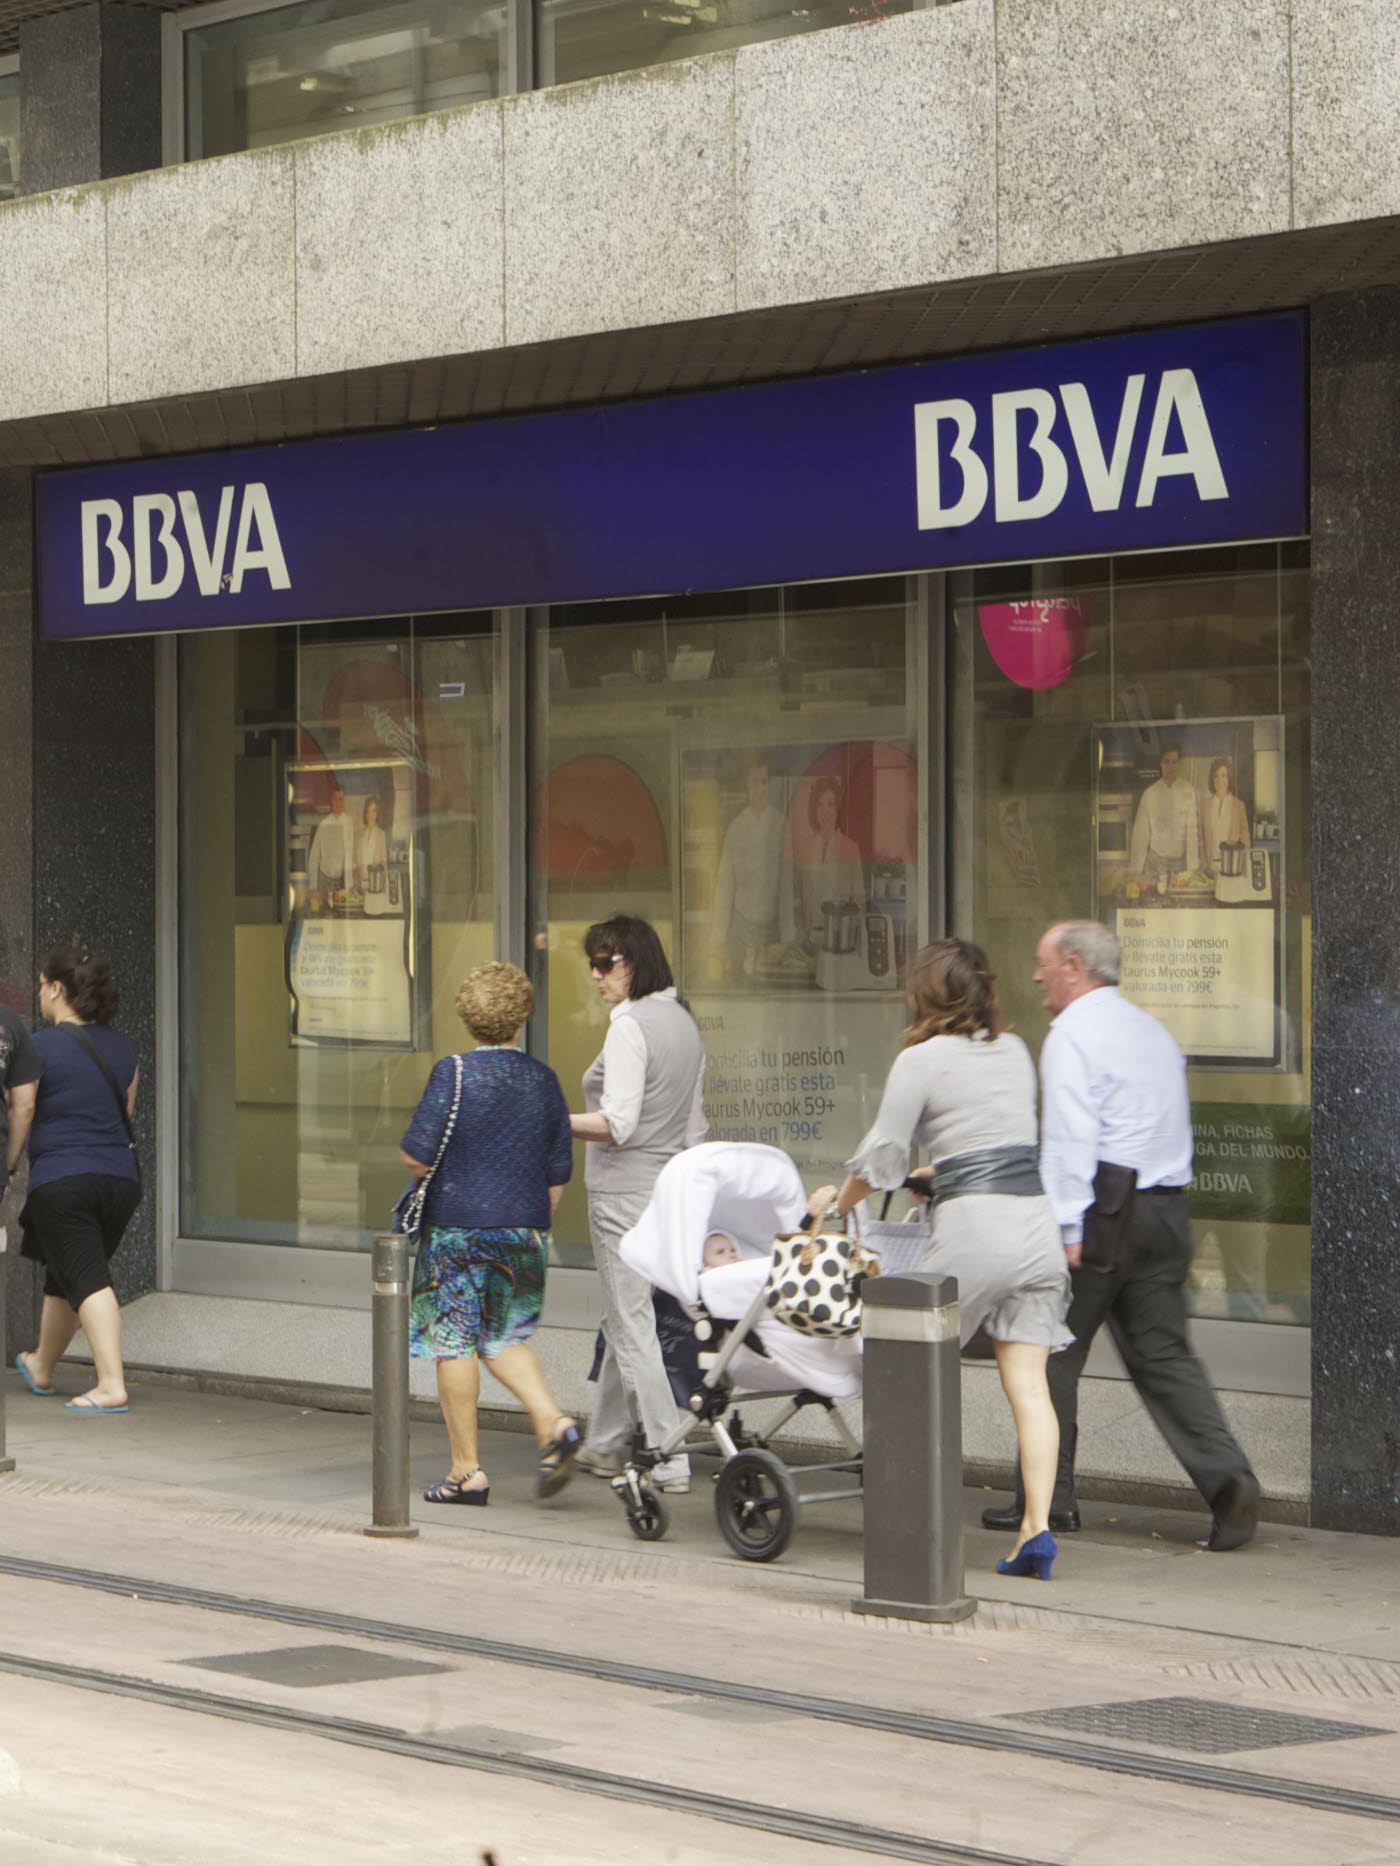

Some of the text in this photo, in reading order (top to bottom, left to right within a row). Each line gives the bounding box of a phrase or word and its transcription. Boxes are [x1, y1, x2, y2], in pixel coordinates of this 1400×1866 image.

[914, 368, 1229, 531] BBVA
[81, 482, 292, 605] BBVA
[1173, 938, 1184, 948] tu
[1187, 936, 1229, 950] pensión
[1168, 951, 1198, 965] gratis
[1200, 953, 1222, 963] esta
[1123, 966, 1222, 980] taurus Mycook 59+
[1123, 981, 1213, 994] valorada en 799€
[706, 1046, 845, 1070] omicilia tu pensión
[756, 1073, 798, 1096] gratis
[801, 1073, 836, 1091] esta
[704, 1096, 836, 1120] aurus Mycook 59+
[704, 1121, 823, 1142] alorada en 799€
[1224, 1124, 1274, 1140] FICHAS
[1220, 1143, 1247, 1157] DEL
[1251, 1144, 1311, 1161] MUNDO.
[1200, 1172, 1254, 1194] BBVA
